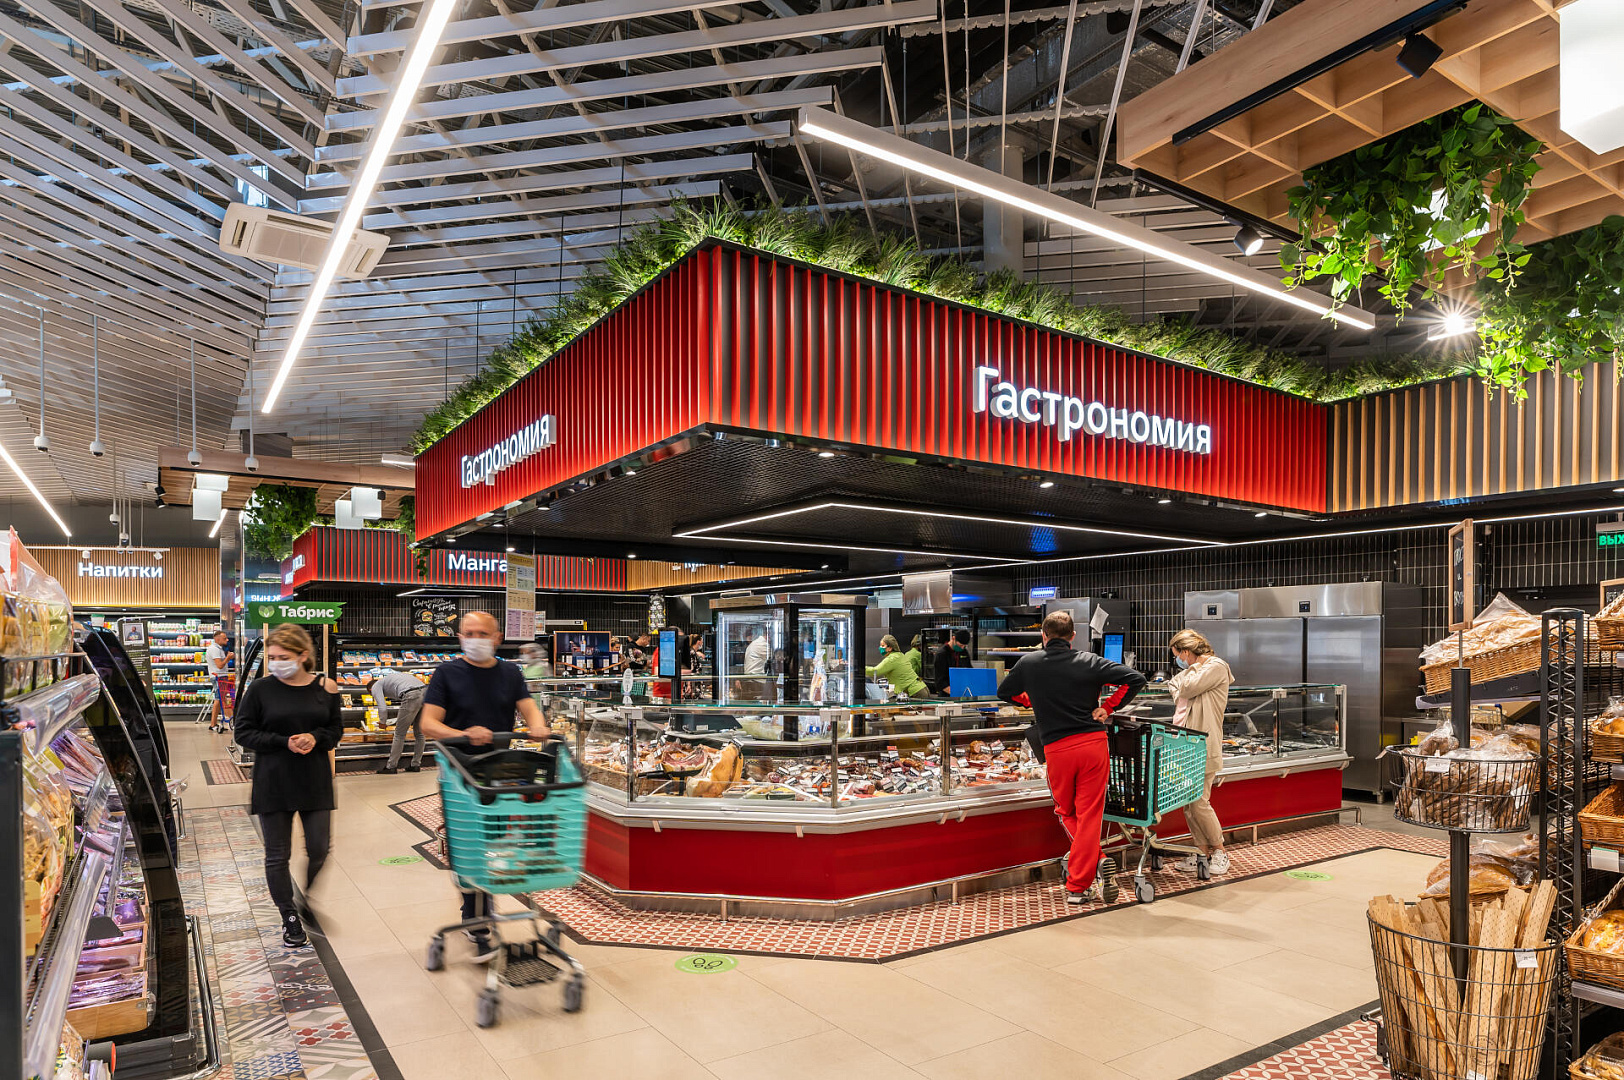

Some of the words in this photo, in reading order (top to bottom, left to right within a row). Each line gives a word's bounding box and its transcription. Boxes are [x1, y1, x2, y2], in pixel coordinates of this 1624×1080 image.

[973, 365, 1212, 455] Гастрономия
[461, 414, 555, 488] Гастрономия
[78, 562, 163, 578] Напитки
[448, 553, 508, 572] Манга
[278, 605, 335, 620] Табрис
